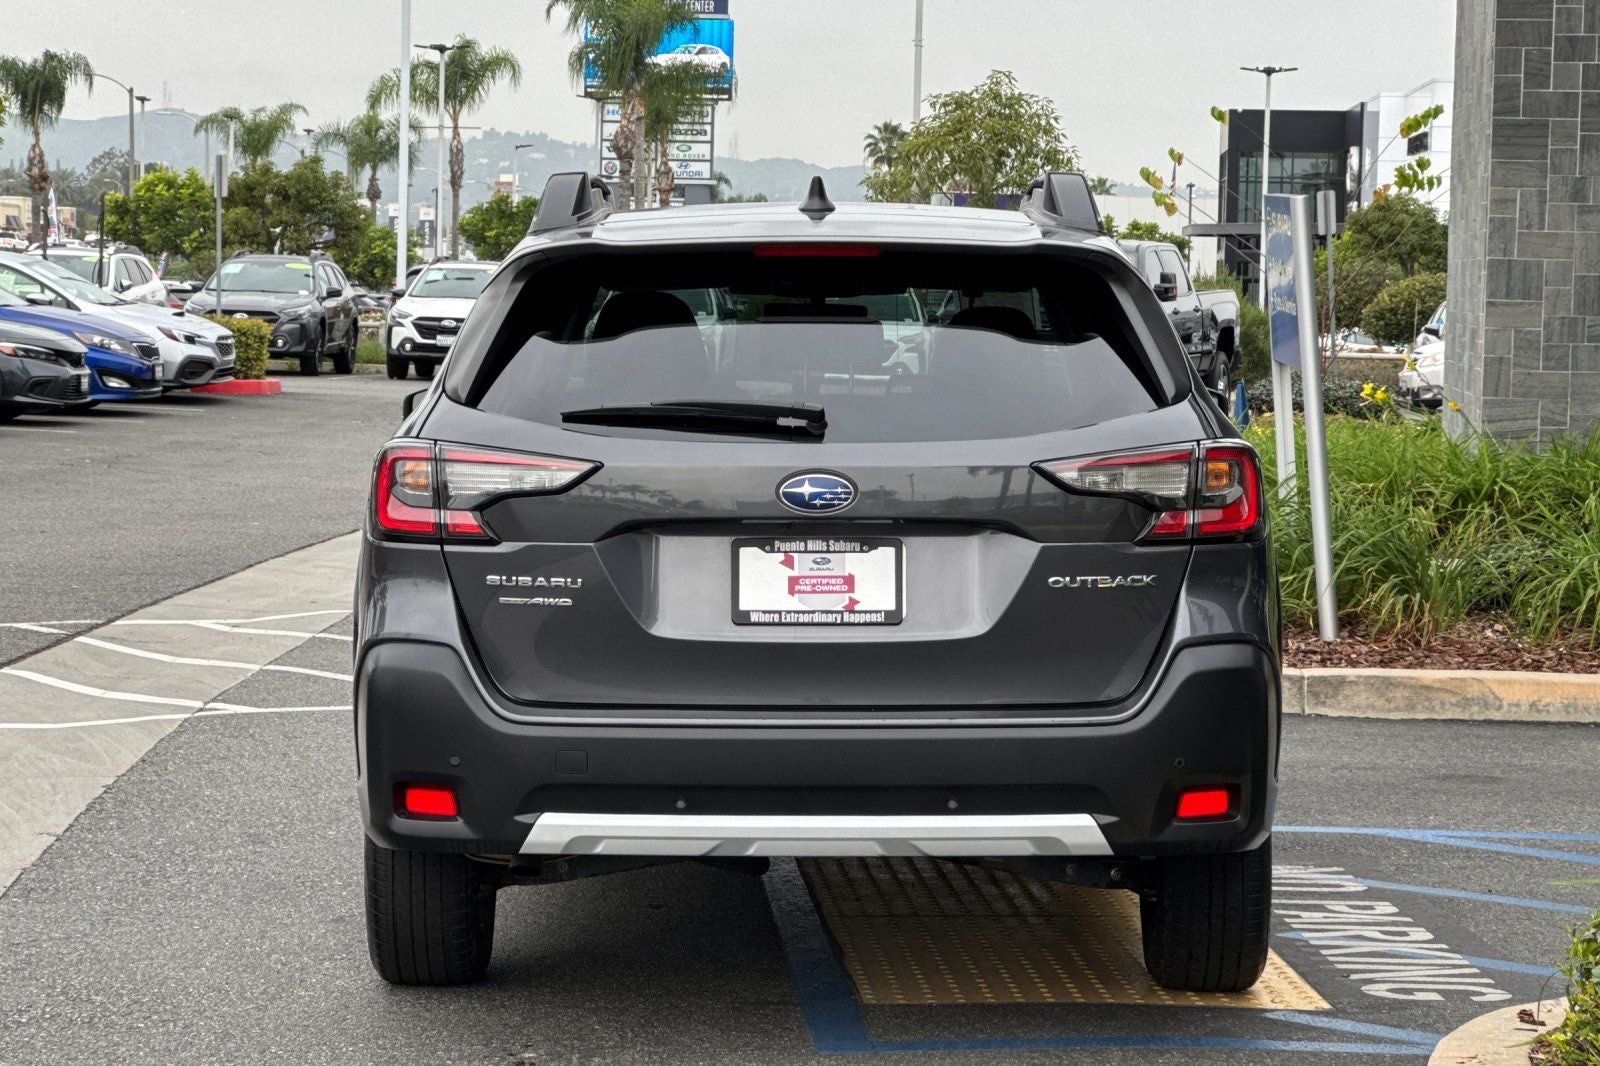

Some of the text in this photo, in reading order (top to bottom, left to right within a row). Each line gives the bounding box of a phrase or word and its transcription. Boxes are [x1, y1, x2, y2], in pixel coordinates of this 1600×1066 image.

[774, 540, 860, 551] Puente Hills Subaru
[486, 575, 582, 588] SUBARU
[1048, 575, 1157, 588] OUTBACK
[525, 597, 573, 606] AWD
[750, 611, 885, 623] Where Extraordinary Happens!
[1272, 900, 1513, 1002] PARKING
